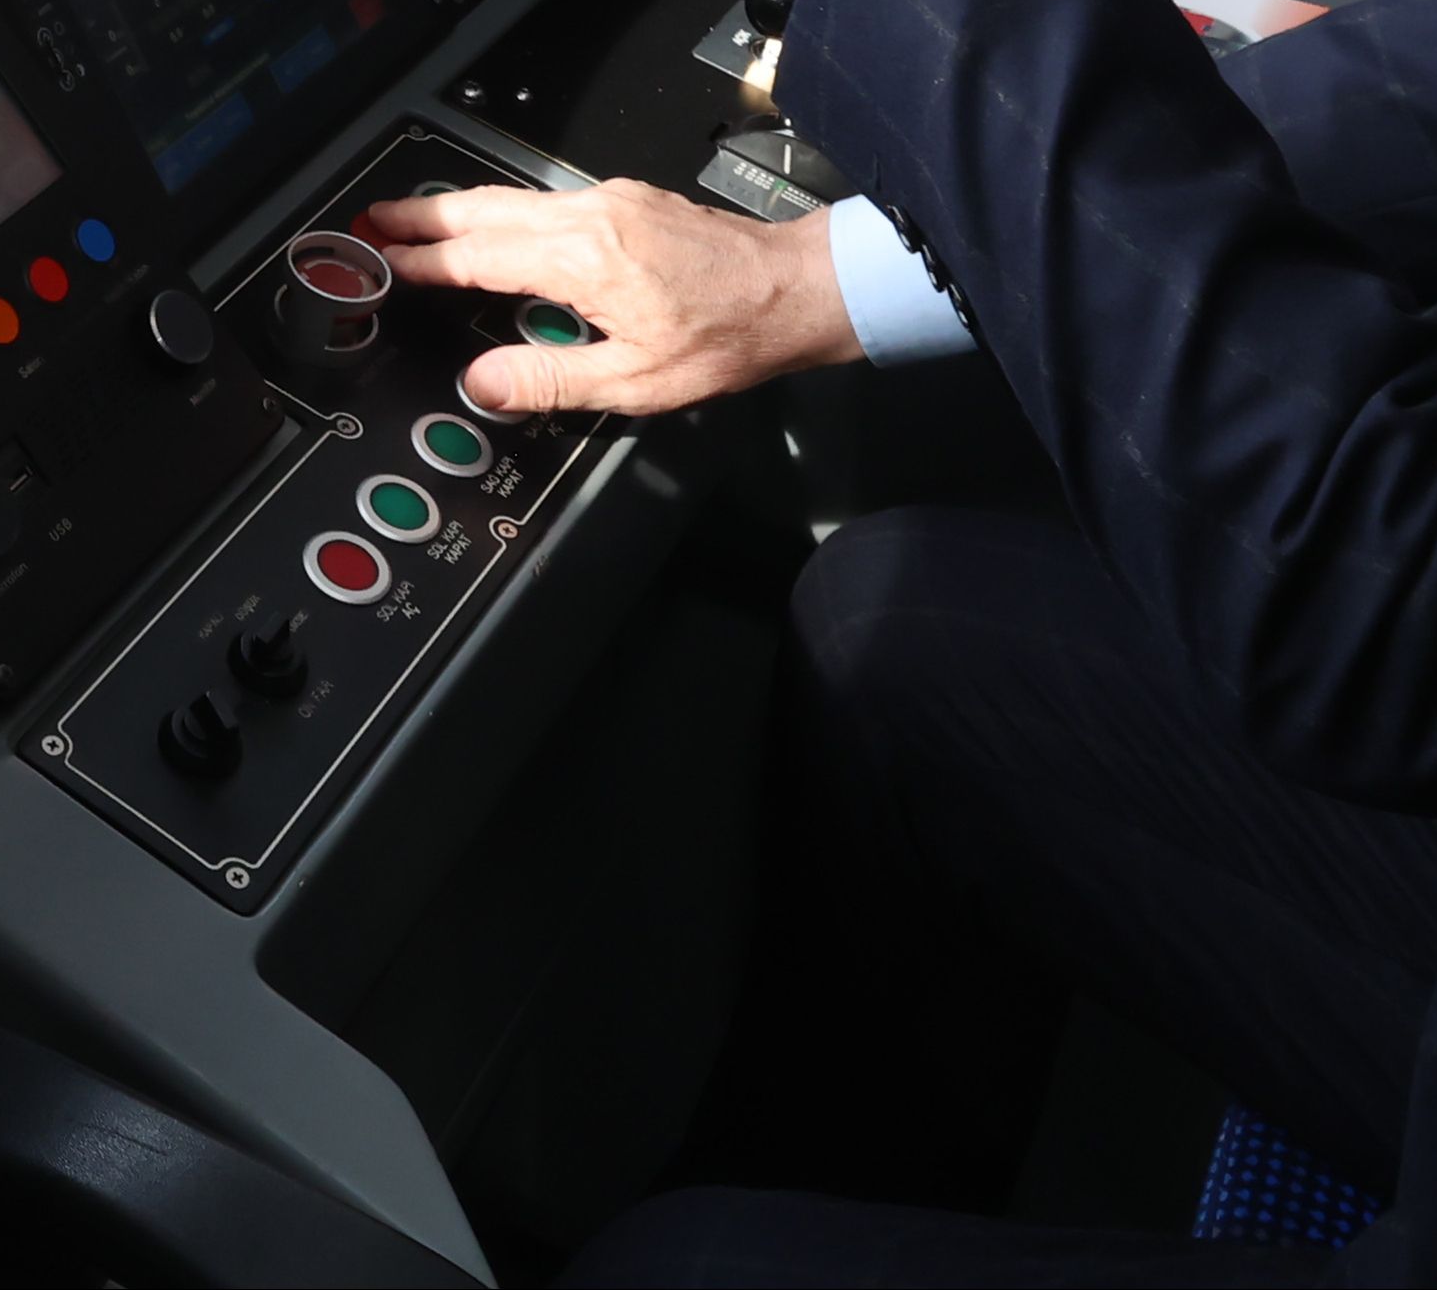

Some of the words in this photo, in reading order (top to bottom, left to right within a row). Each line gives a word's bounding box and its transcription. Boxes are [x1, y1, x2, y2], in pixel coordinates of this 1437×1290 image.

[493, 454, 517, 478] KAPI
[496, 468, 525, 499] KAPAT
[48, 516, 73, 542] USB
[426, 541, 449, 561] SOL
[443, 519, 465, 544] KAPI
[443, 532, 473, 566] KAPAT
[376, 602, 399, 623] SOL
[393, 580, 416, 604] KAPI
[401, 601, 423, 621] AÇ
[310, 679, 335, 703] FAR
